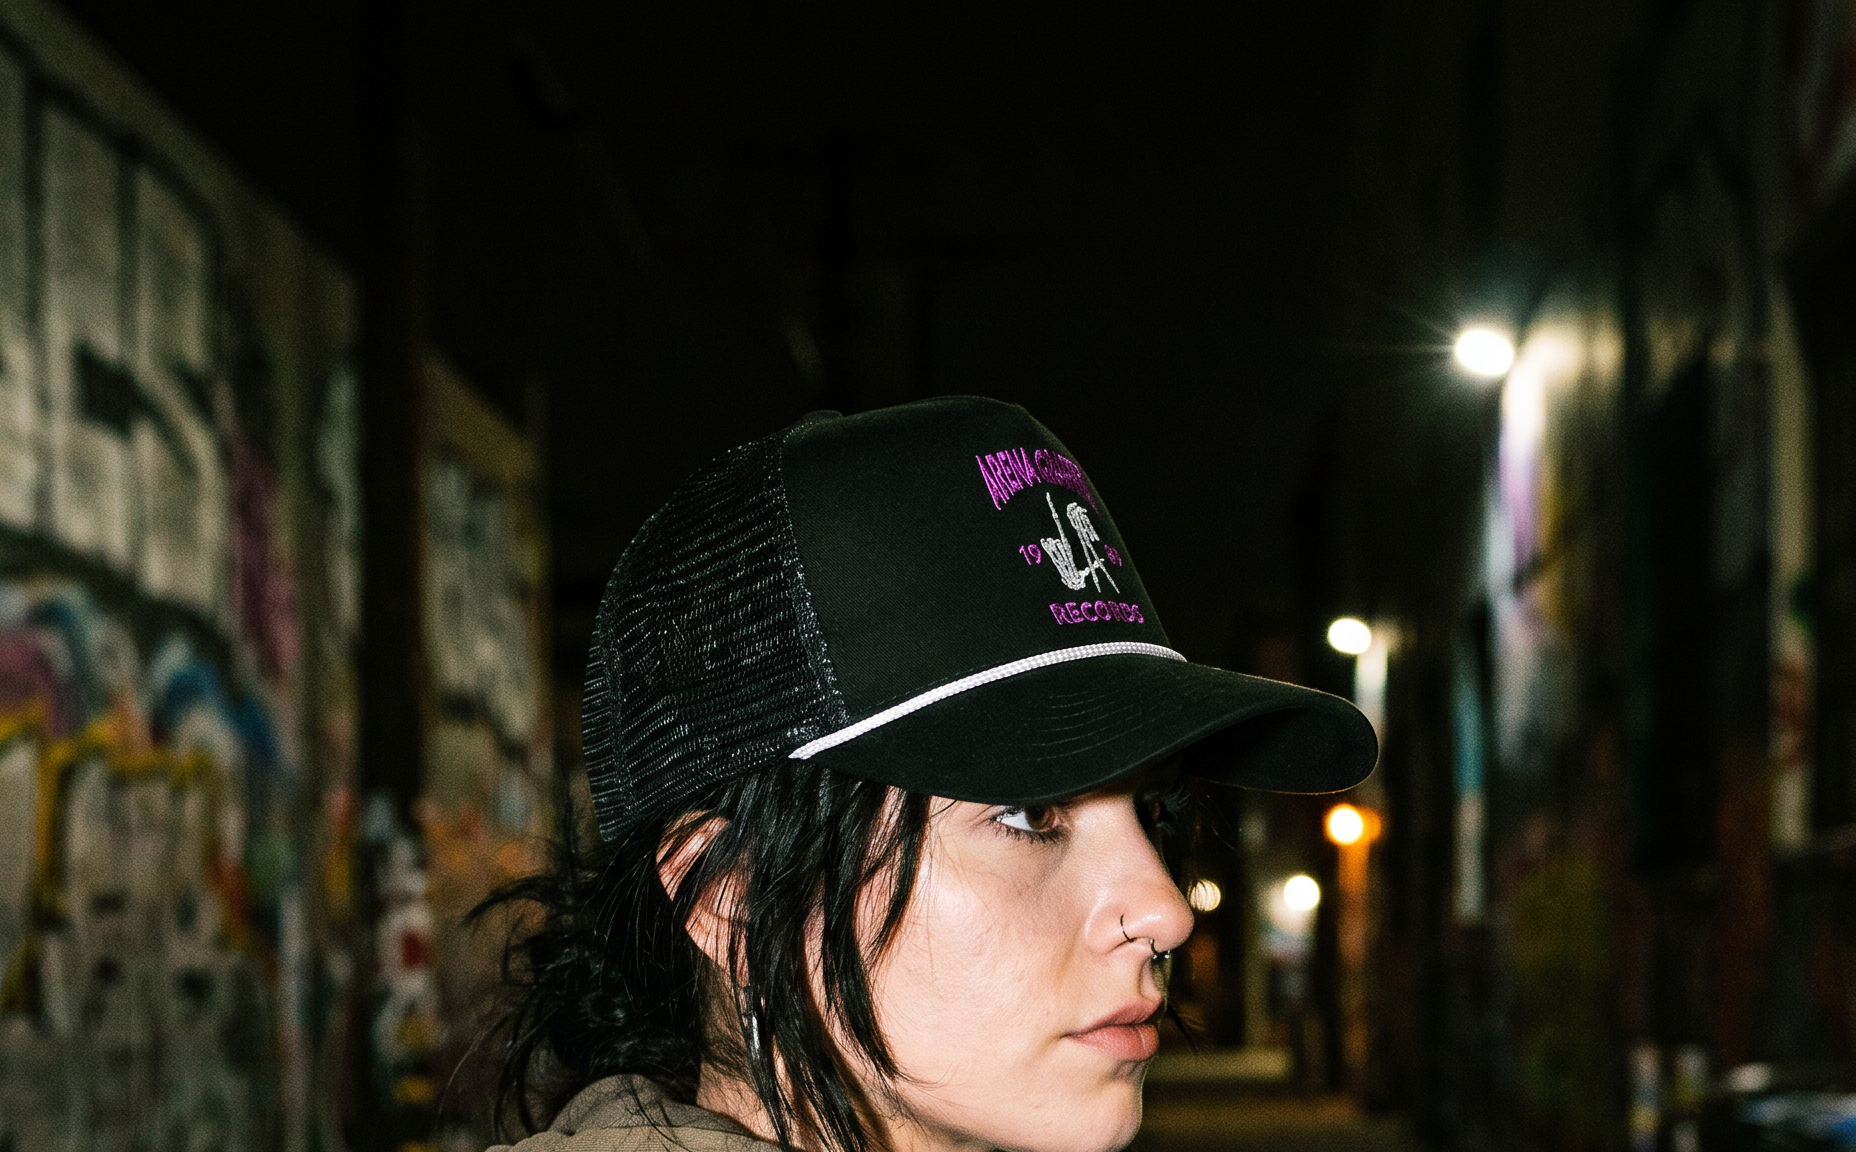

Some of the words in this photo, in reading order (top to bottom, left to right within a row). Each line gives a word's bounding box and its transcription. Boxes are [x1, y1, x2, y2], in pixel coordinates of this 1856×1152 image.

[975, 447, 1042, 511] ARENA
[1019, 543, 1043, 565] 19
[1049, 599, 1145, 625] RECORDS
